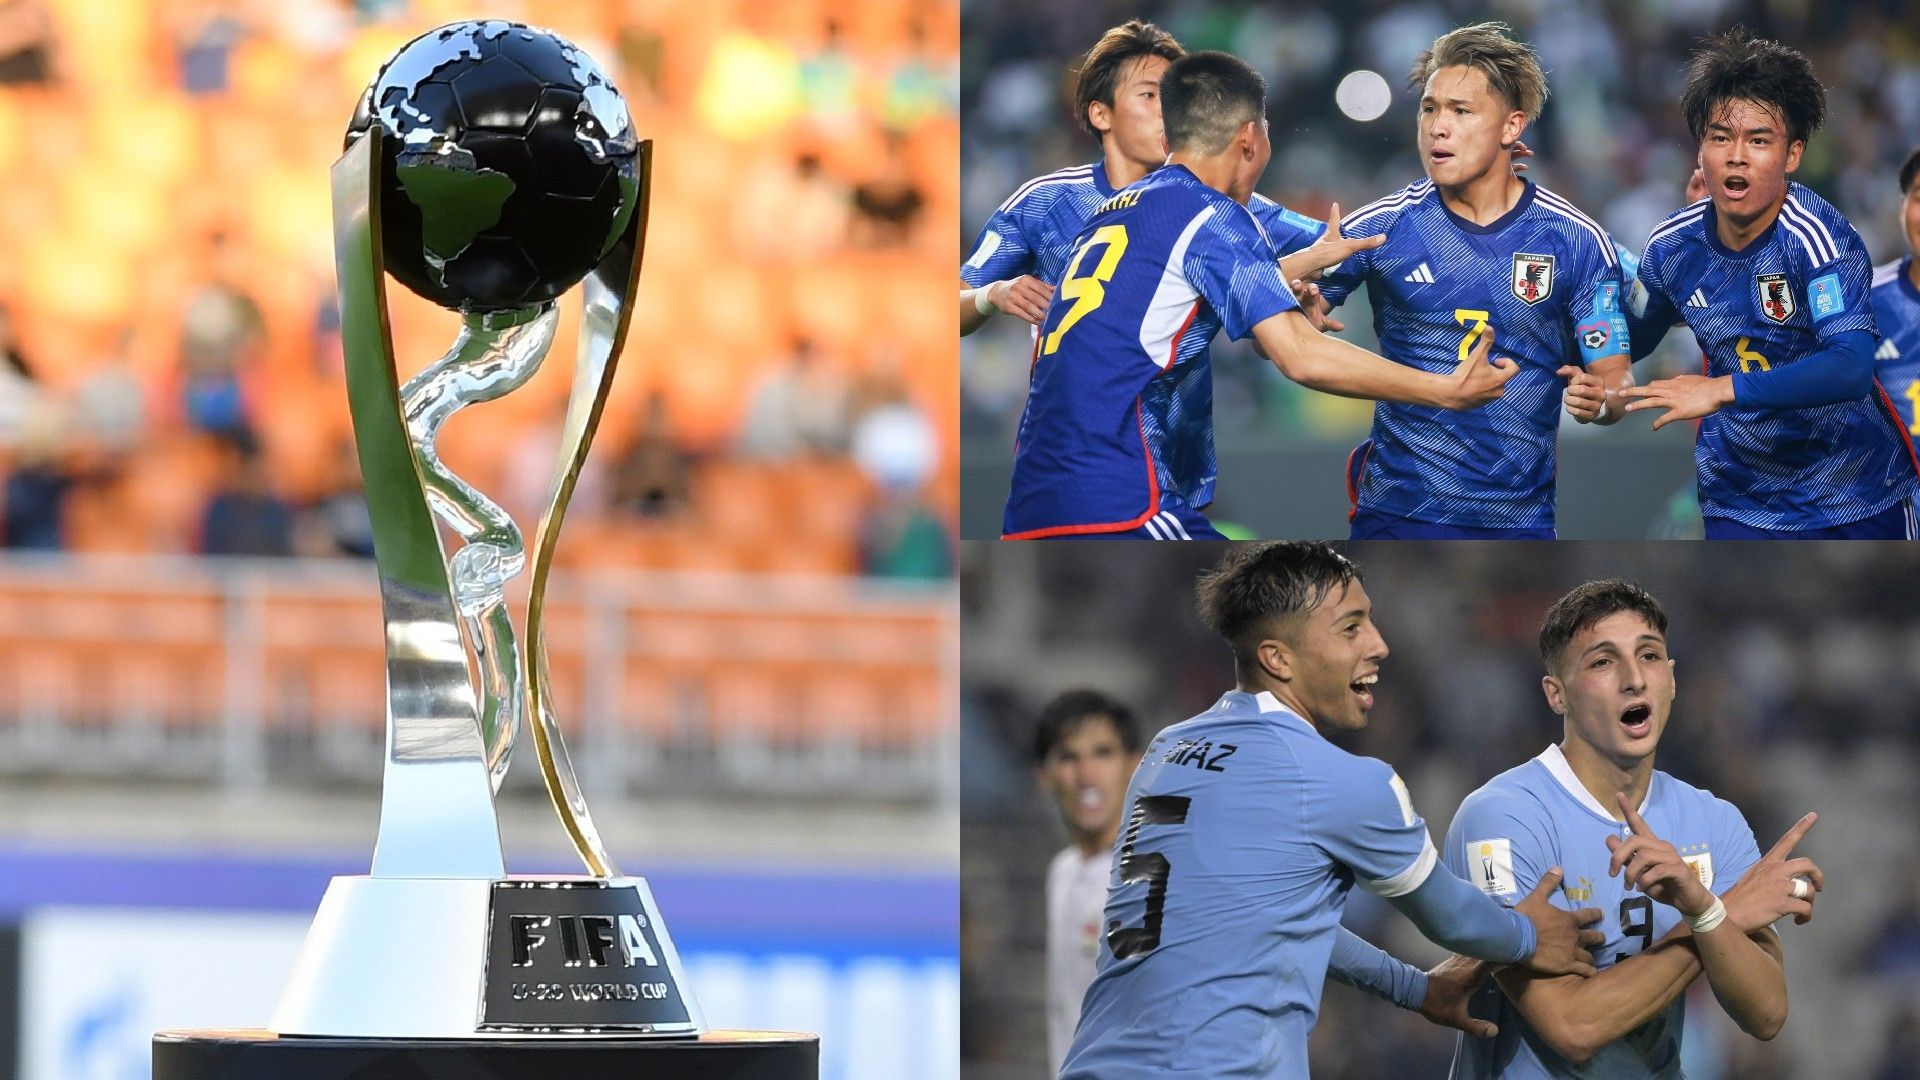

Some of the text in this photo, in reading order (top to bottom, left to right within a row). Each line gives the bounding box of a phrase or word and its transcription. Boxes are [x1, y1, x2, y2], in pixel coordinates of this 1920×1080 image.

[1521, 288, 1540, 298] JFA
[1455, 309, 1489, 360] 7
[1107, 795, 1192, 960] 5
[1615, 895, 1654, 964] 9
[511, 982, 668, 1002] U-20 WORLD CUP
